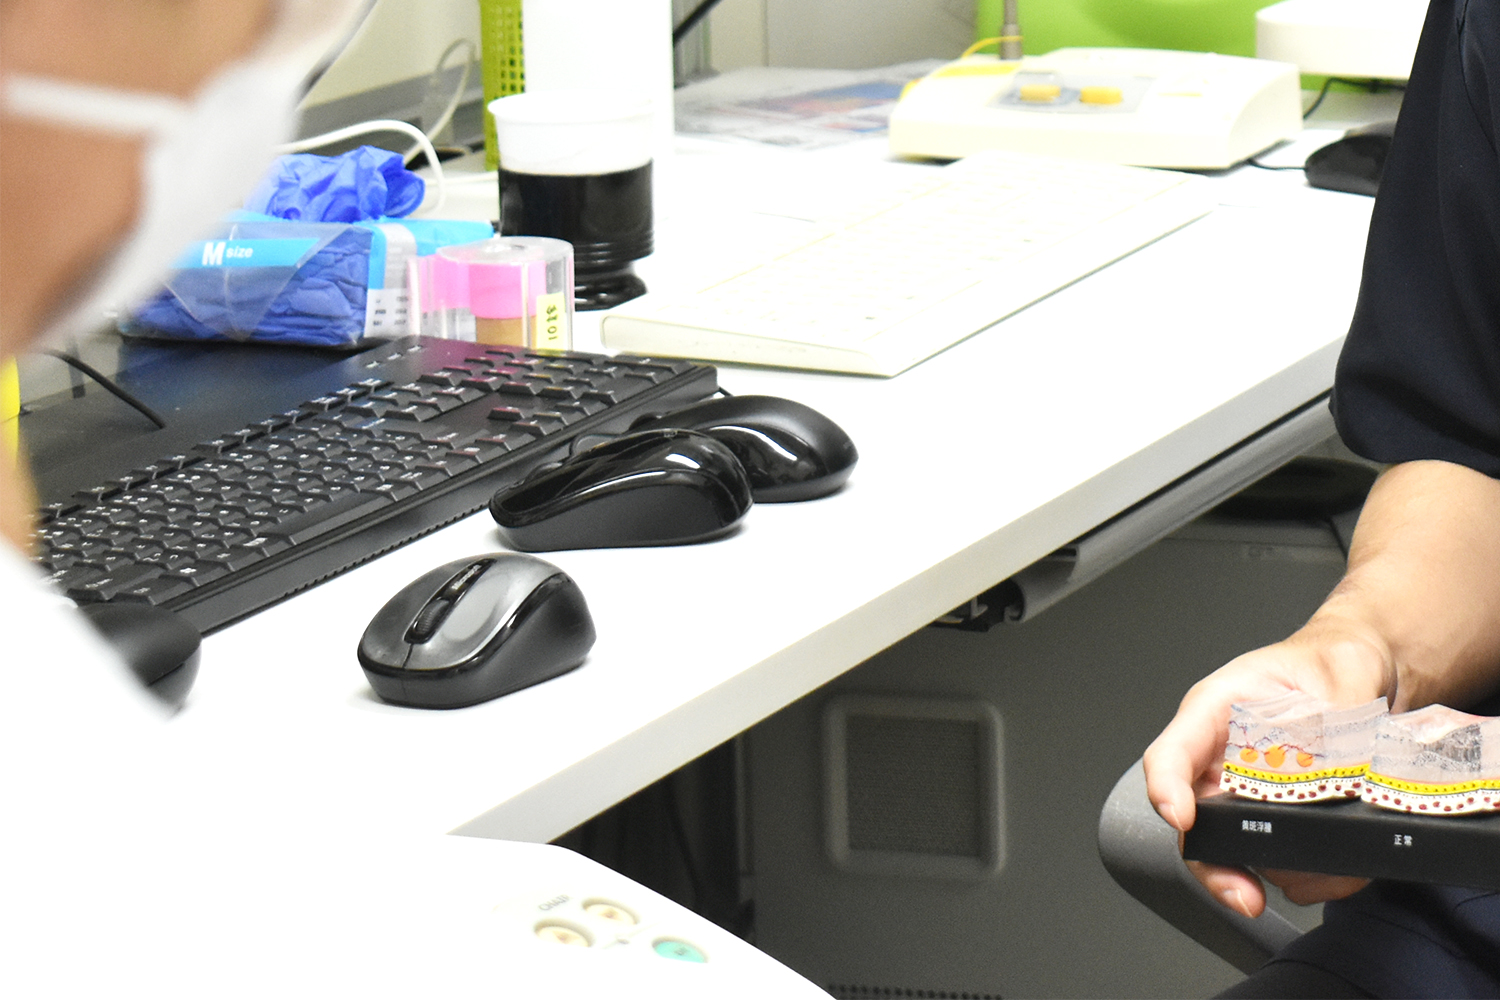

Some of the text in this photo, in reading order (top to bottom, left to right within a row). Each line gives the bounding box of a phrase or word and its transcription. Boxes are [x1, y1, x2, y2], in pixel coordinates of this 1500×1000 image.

[202, 241, 254, 266] M size
[1393, 833, 1413, 847] 正常
